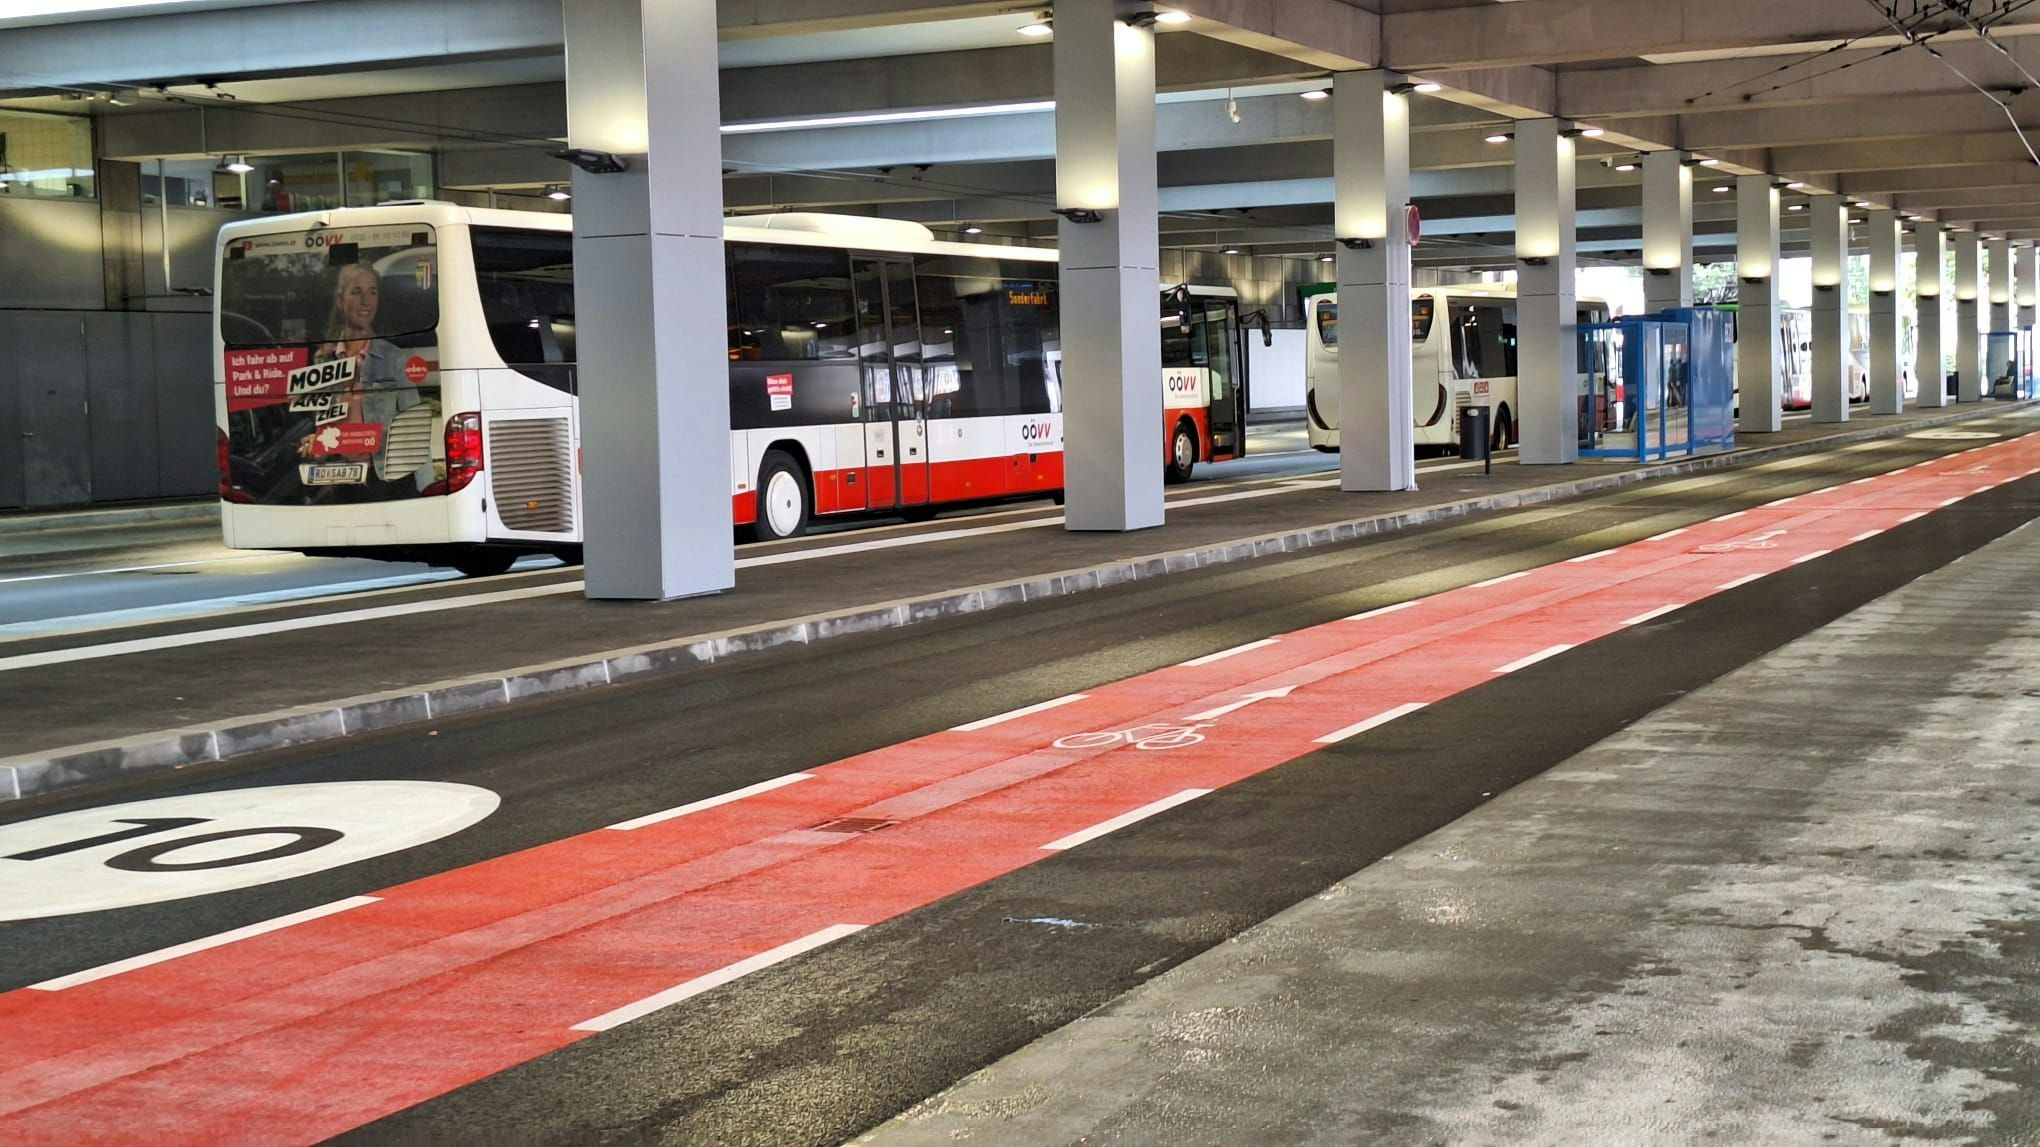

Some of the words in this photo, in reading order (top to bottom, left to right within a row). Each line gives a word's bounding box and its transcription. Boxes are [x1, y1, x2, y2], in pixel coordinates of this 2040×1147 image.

[1009, 290, 1047, 304] Sonderfahrt
[232, 356, 245, 366] Ich
[247, 354, 264, 365] fahr
[266, 353, 277, 364] ab
[279, 352, 294, 362] auf
[232, 370, 252, 381] Park
[254, 370, 261, 380] &
[263, 367, 285, 379] Ride.
[289, 361, 352, 392] MOBIL
[1169, 371, 1196, 391] OÖVV
[234, 384, 252, 396] Und
[253, 383, 270, 395] du?
[293, 392, 332, 408] ANS
[317, 404, 346, 421] ZIEL
[1022, 419, 1051, 440] OÖVV
[1, 817, 345, 872] 10
